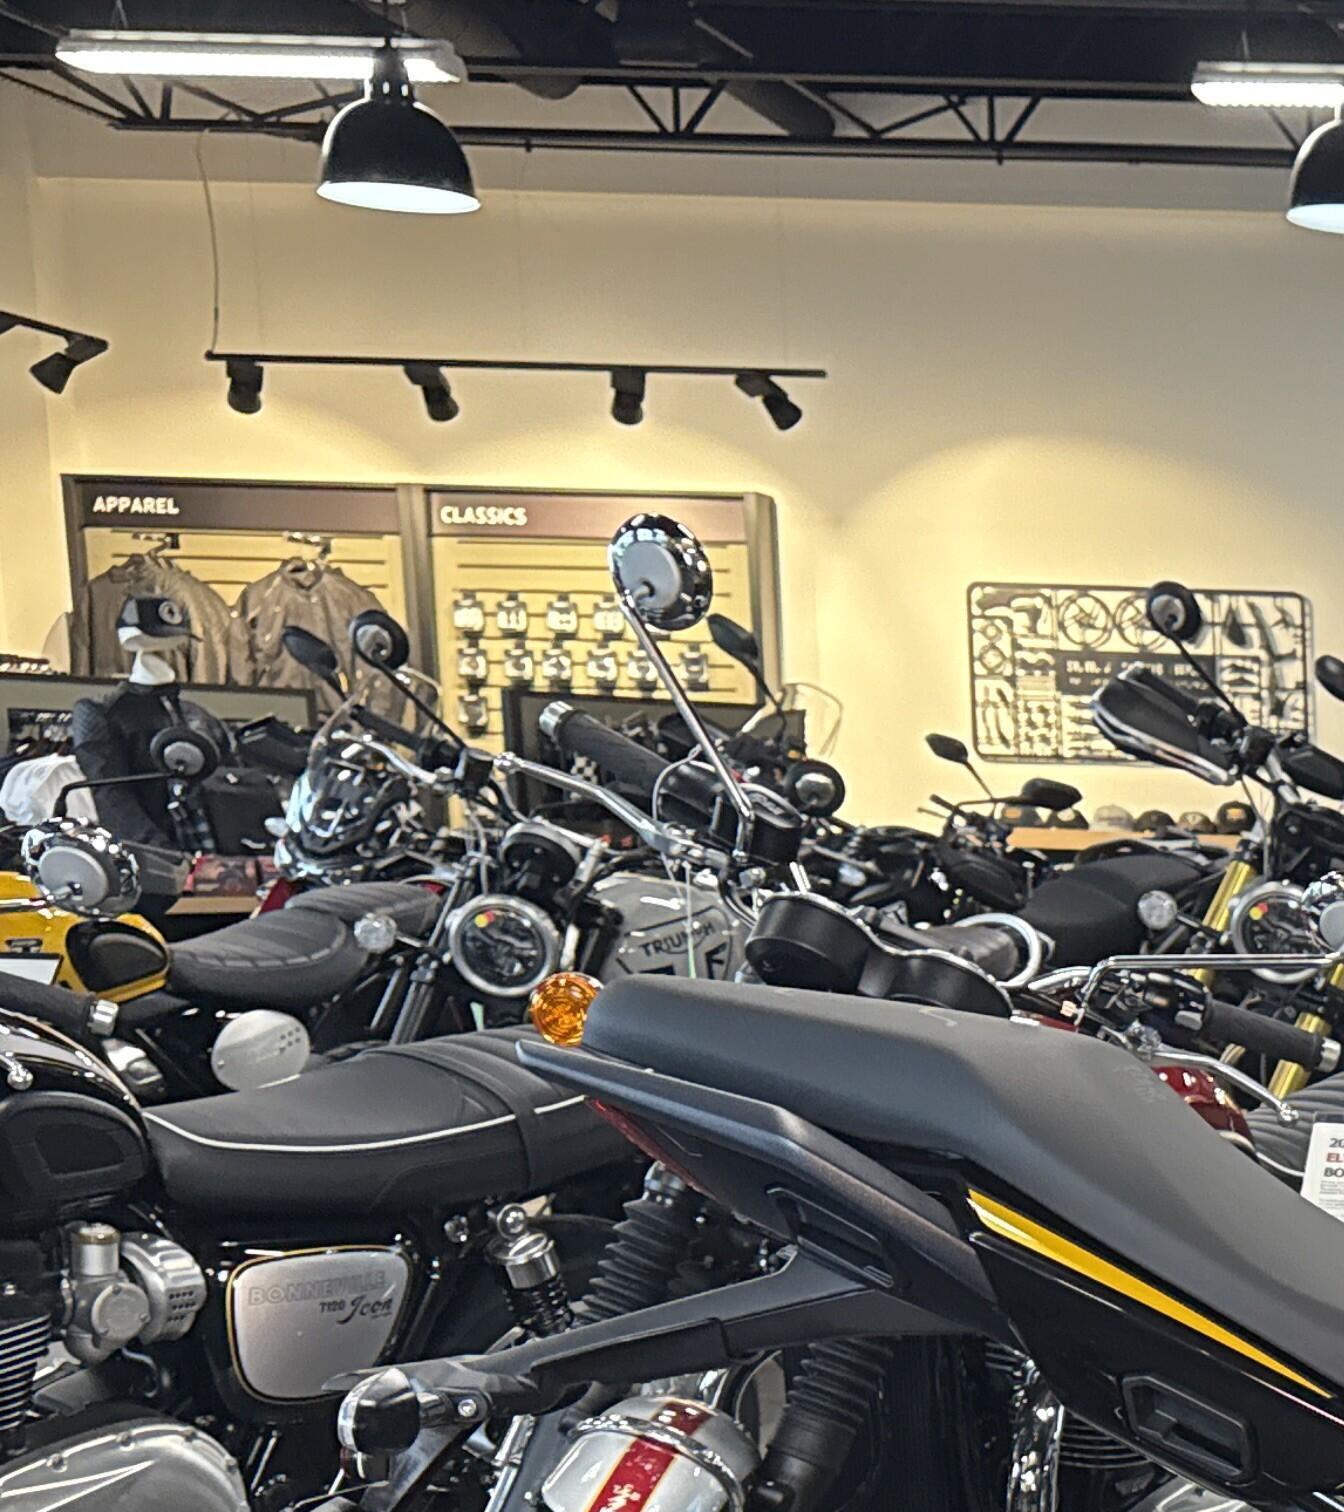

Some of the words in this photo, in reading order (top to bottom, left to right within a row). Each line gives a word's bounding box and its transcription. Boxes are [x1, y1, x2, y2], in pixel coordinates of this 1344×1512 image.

[92, 495, 181, 516] APPAREL
[440, 506, 528, 526] CLASSICS
[248, 1270, 386, 1307] BONNEVILLE
